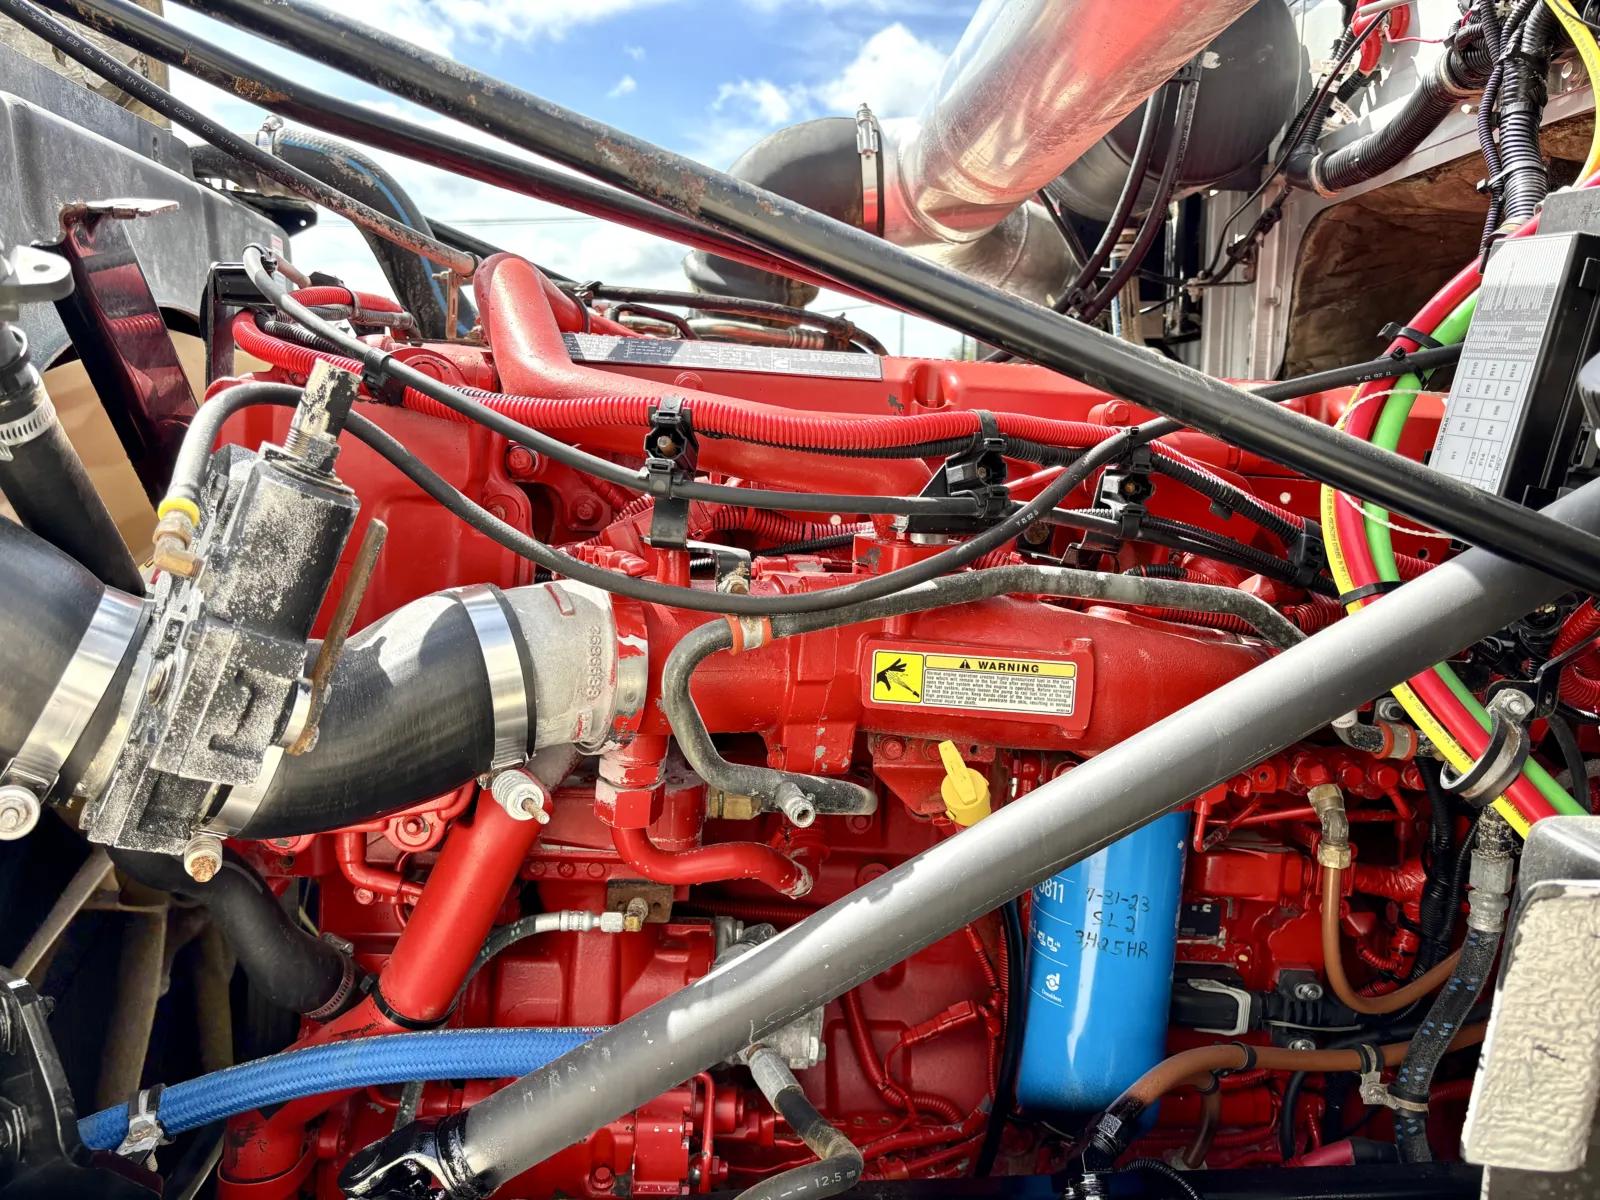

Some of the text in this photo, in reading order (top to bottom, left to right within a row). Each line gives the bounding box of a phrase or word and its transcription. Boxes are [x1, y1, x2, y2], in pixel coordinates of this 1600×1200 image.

[99, 57, 123, 74] MADE
[126, 76, 138, 86] IN
[140, 84, 169, 108] U.S.A.
[978, 661, 1039, 673] WARNING
[1086, 888, 1150, 912] 7-31-23
[814, 1172, 842, 1188] 12.5
